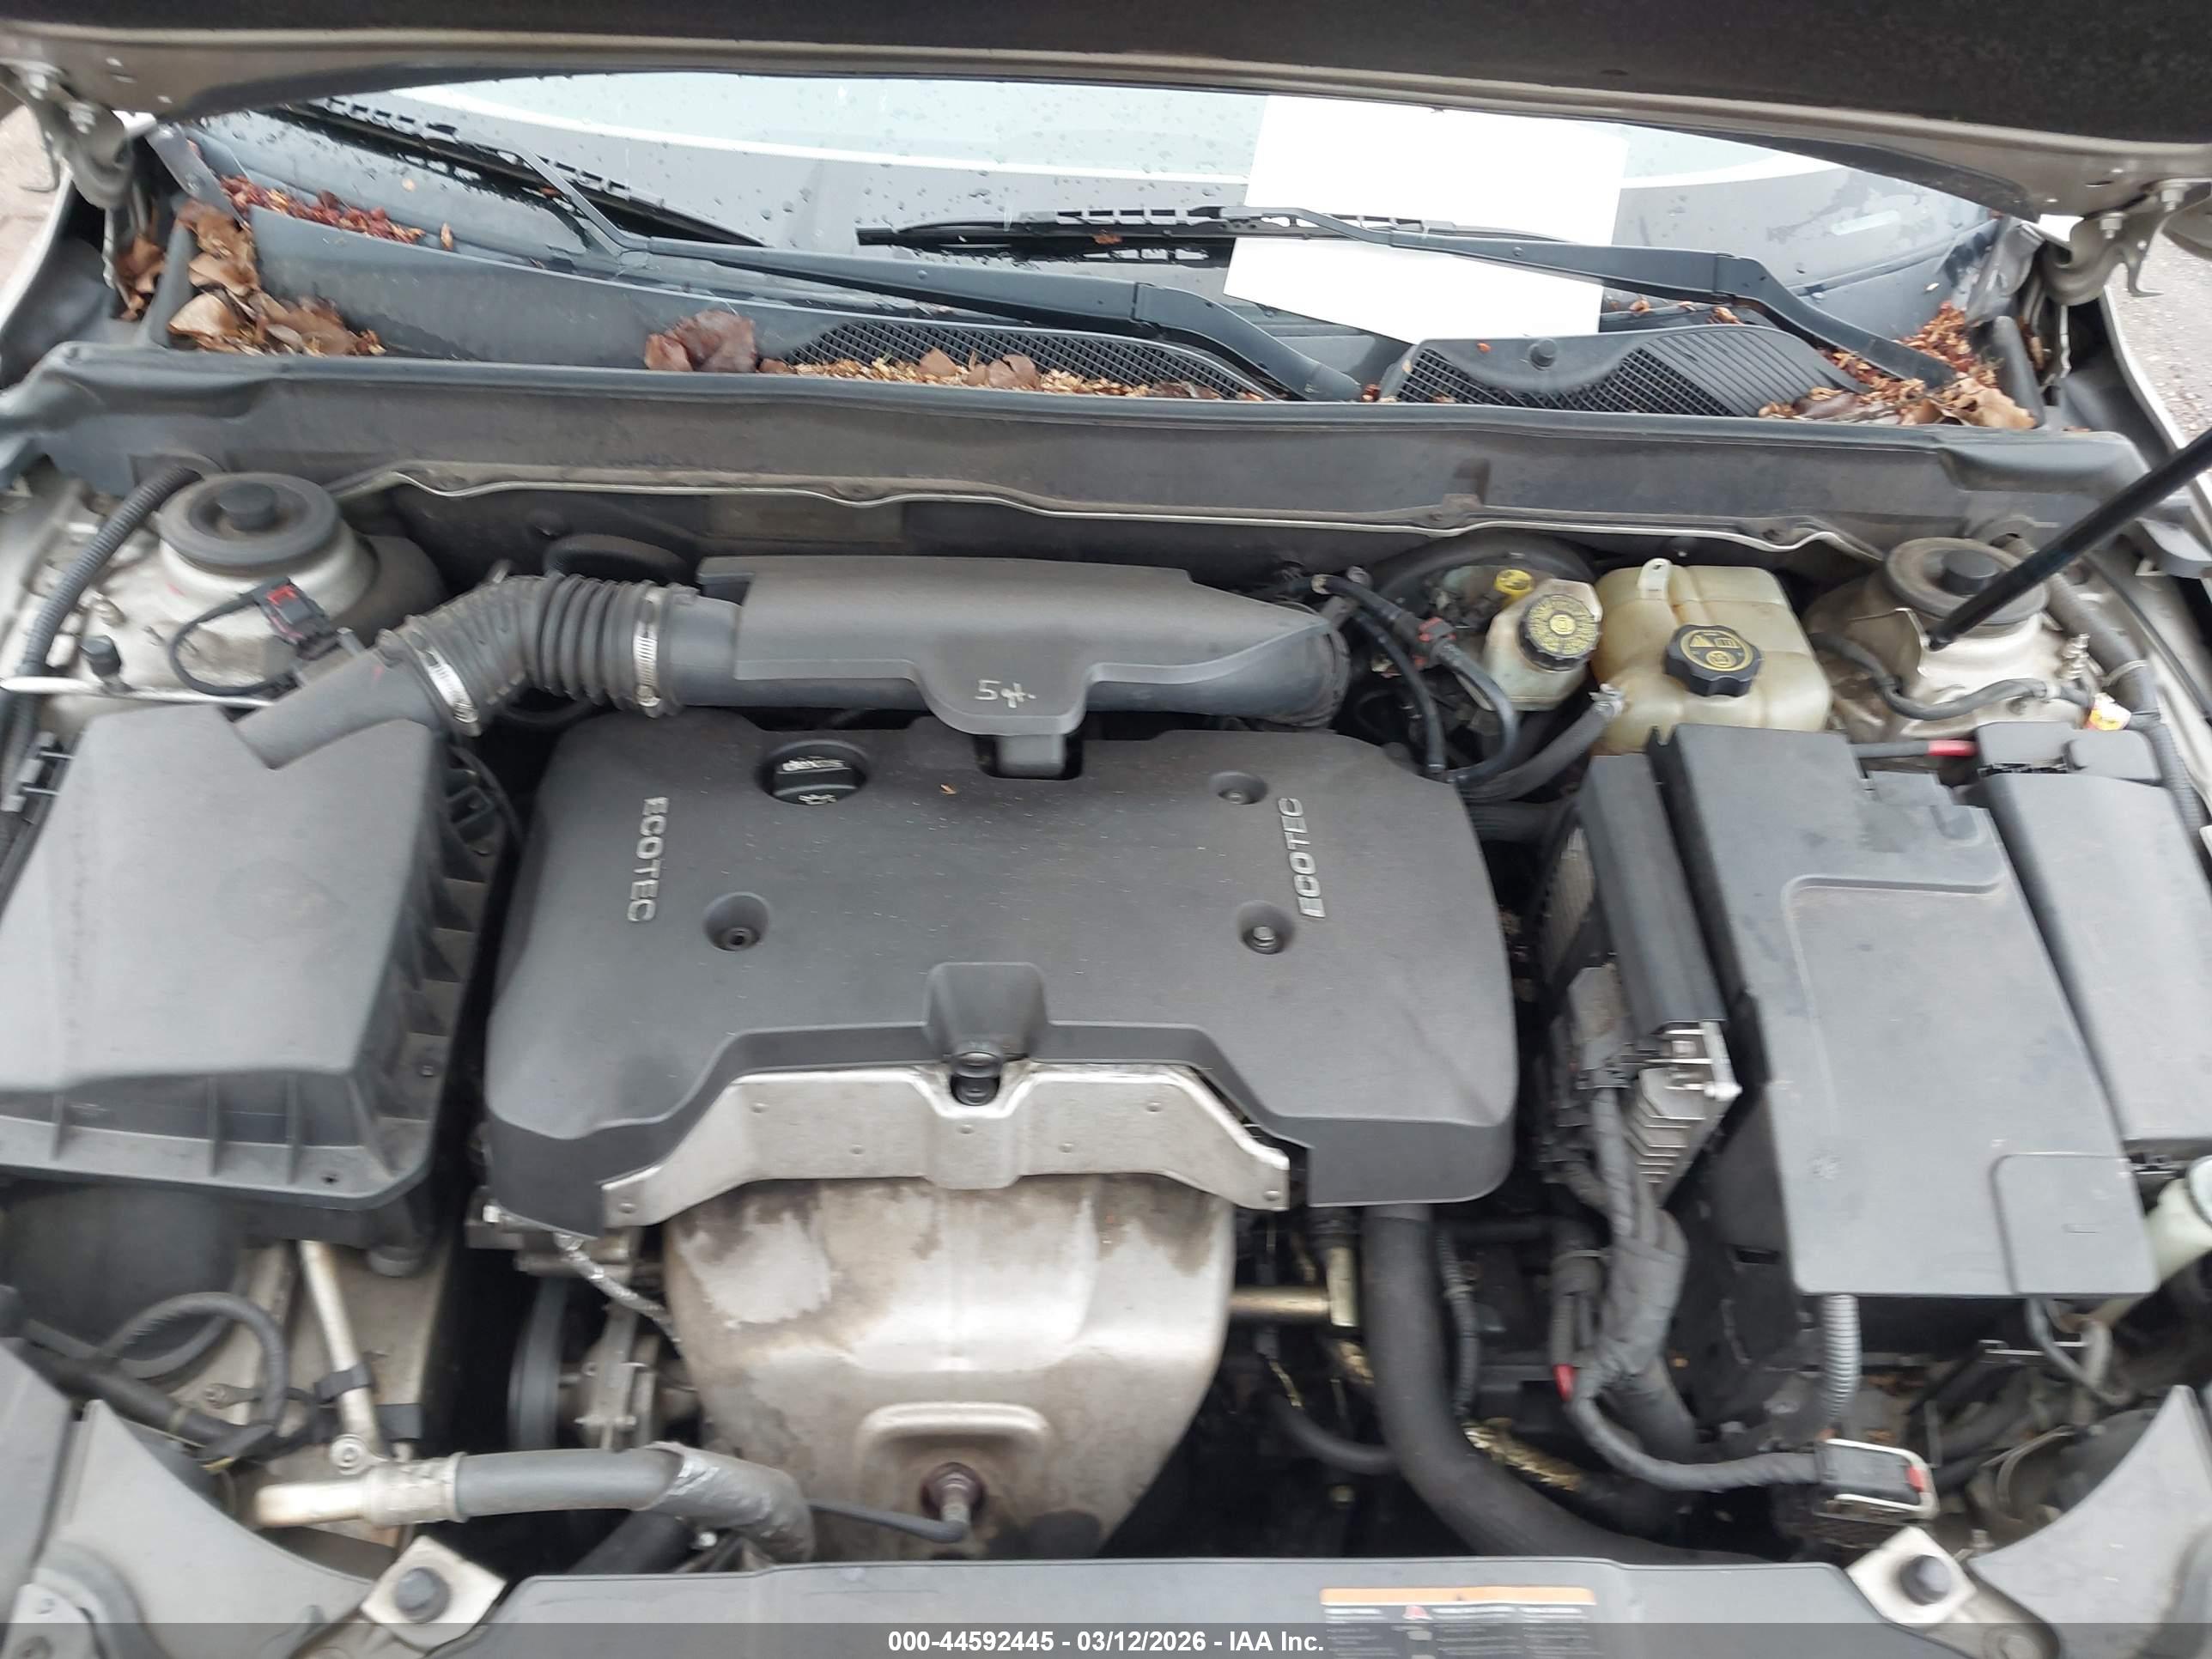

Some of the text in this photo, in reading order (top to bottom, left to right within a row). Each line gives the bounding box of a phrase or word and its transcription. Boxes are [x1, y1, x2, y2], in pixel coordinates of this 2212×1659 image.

[975, 679, 1001, 700] 5
[627, 796, 669, 921] ECOTEC
[1278, 797, 1326, 918] ECOTEC
